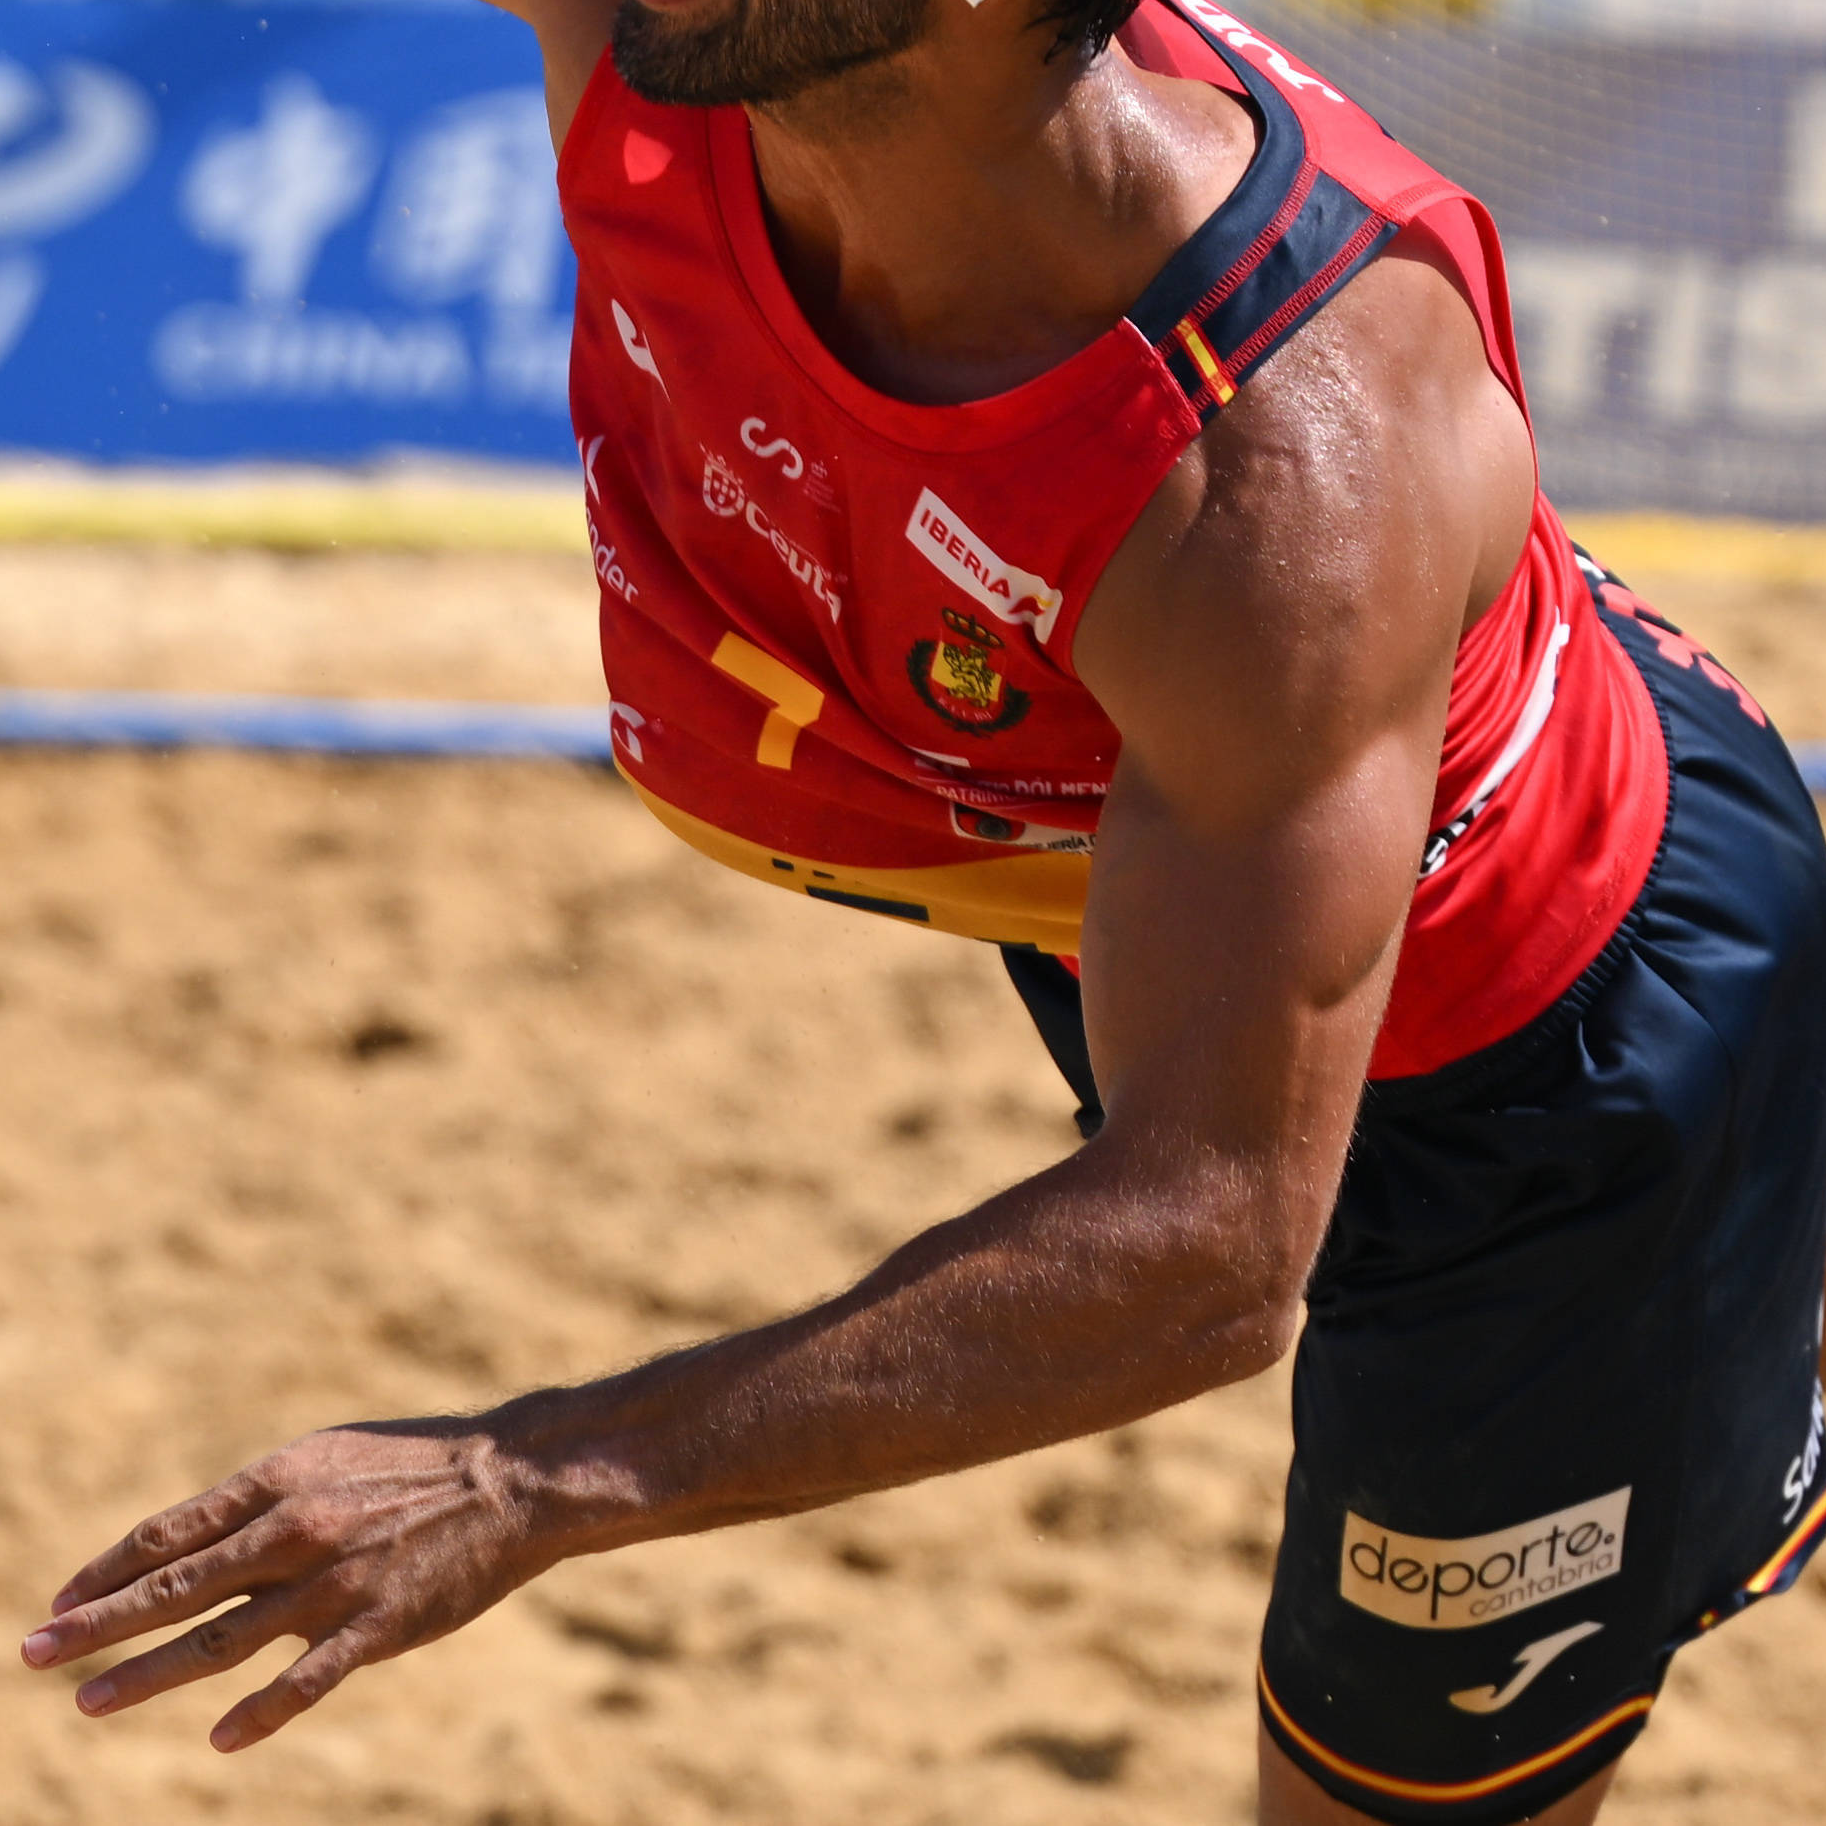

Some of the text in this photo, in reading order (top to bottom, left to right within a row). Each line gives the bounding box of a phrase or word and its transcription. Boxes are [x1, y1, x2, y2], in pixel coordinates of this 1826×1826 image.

[918, 507, 1012, 599] IBERIA
[711, 630, 826, 771] 7
[1468, 1551, 1614, 1618] cantabria
